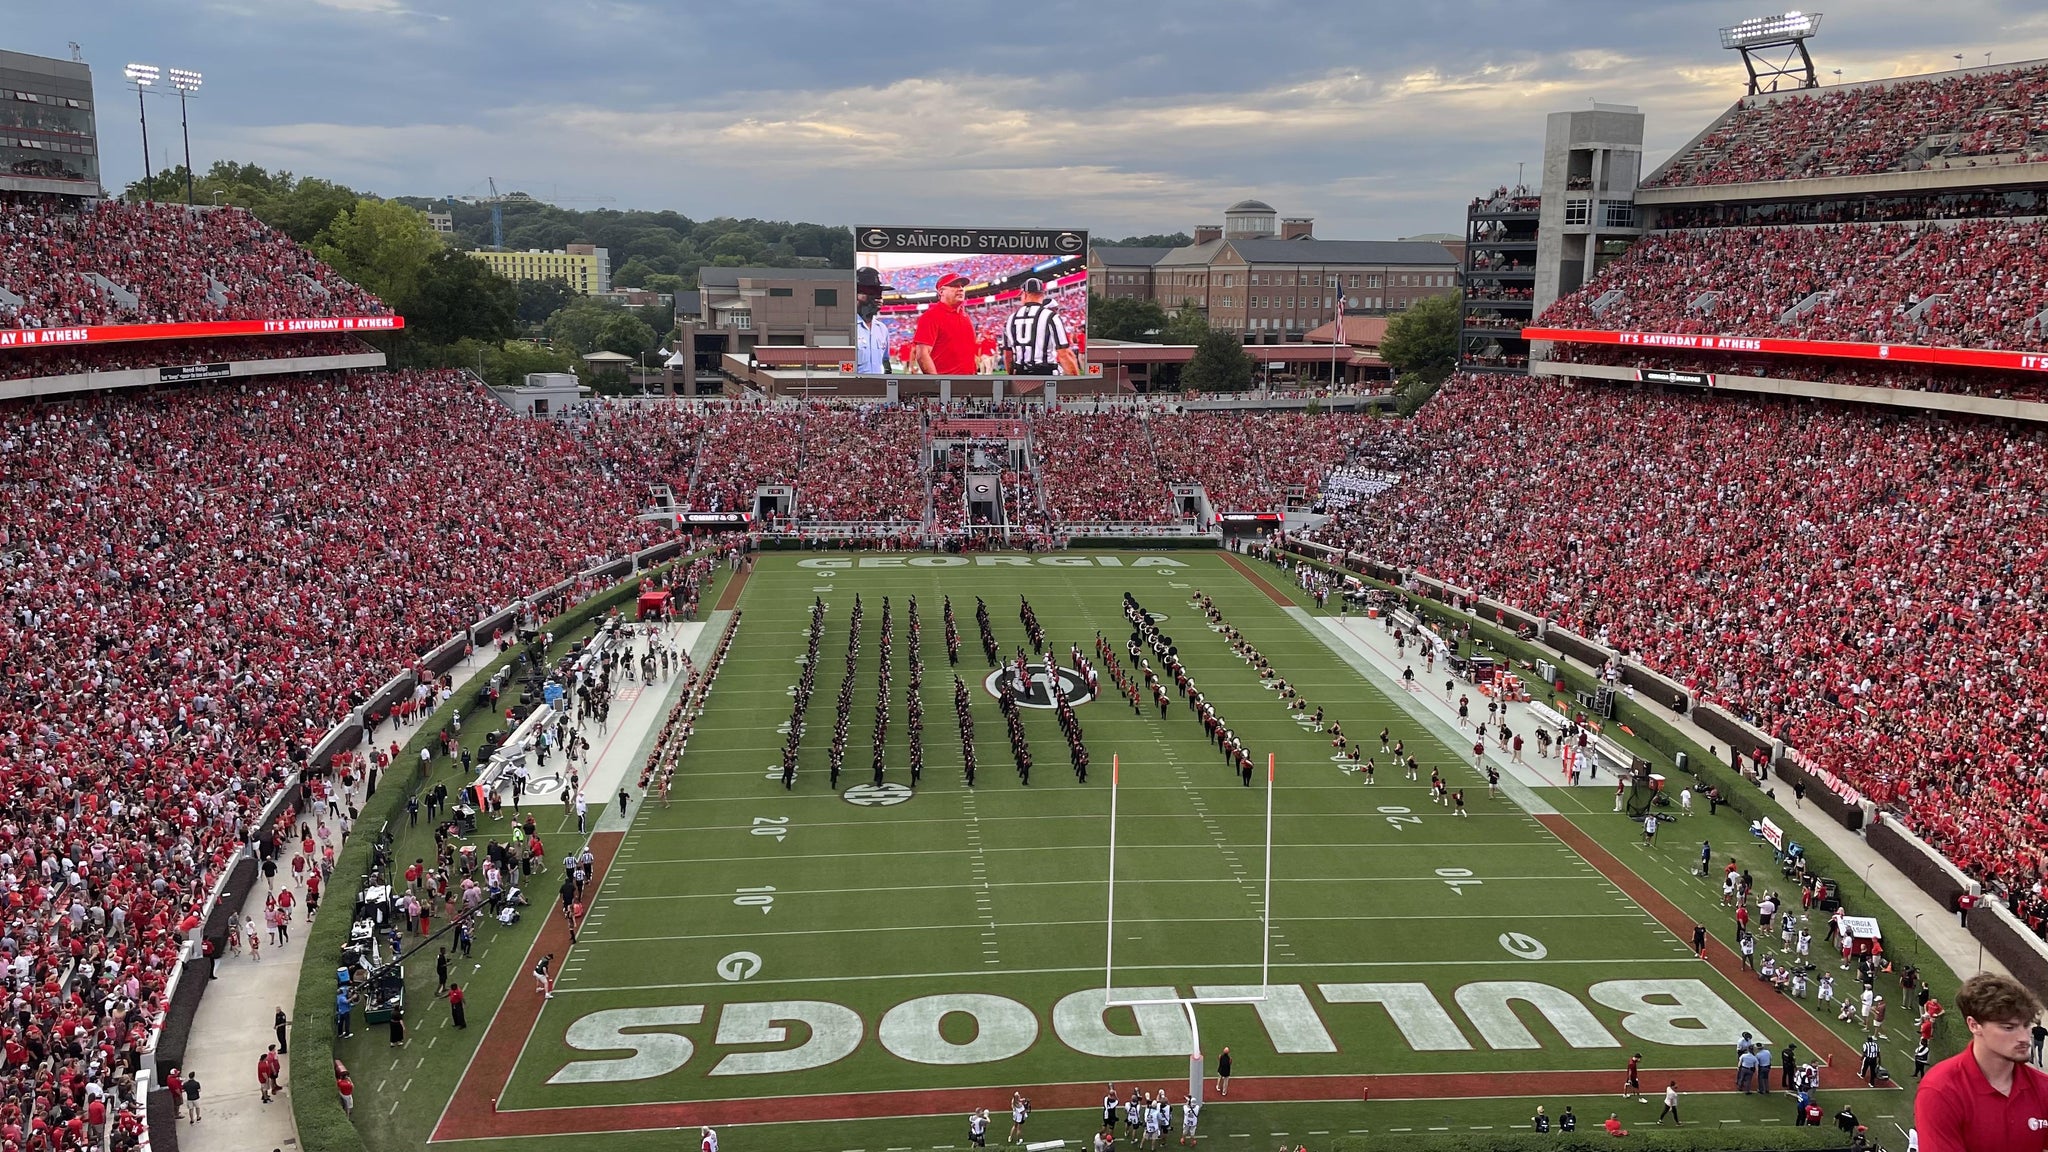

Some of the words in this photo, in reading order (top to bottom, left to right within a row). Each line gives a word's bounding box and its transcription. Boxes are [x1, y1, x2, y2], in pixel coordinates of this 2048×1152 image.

[896, 234, 971, 248] SANFORD
[978, 235, 1049, 249] STADIUM
[264, 321, 285, 331] IT'S
[288, 319, 339, 330] SATURDAY
[343, 319, 354, 329] IN
[357, 317, 394, 328] ATHENS
[1014, 318, 1035, 344] U
[1, 332, 17, 345] AY
[22, 331, 36, 343] IN
[41, 329, 88, 342] ATHENS
[1619, 333, 1639, 343] IT'S
[1643, 335, 1697, 346] SATURDAY
[1701, 337, 1714, 348] IN
[1718, 339, 1761, 350] ATHENS
[2021, 356, 2048, 369] IT'S
[796, 556, 1190, 568] GEORGIA
[1377, 806, 1423, 824] 20
[751, 816, 789, 836] 20
[1435, 868, 1483, 885] 10
[733, 885, 777, 906] 10
[1498, 931, 1548, 960] G
[717, 951, 762, 981] G
[545, 978, 1773, 1085] BULLDOGS
